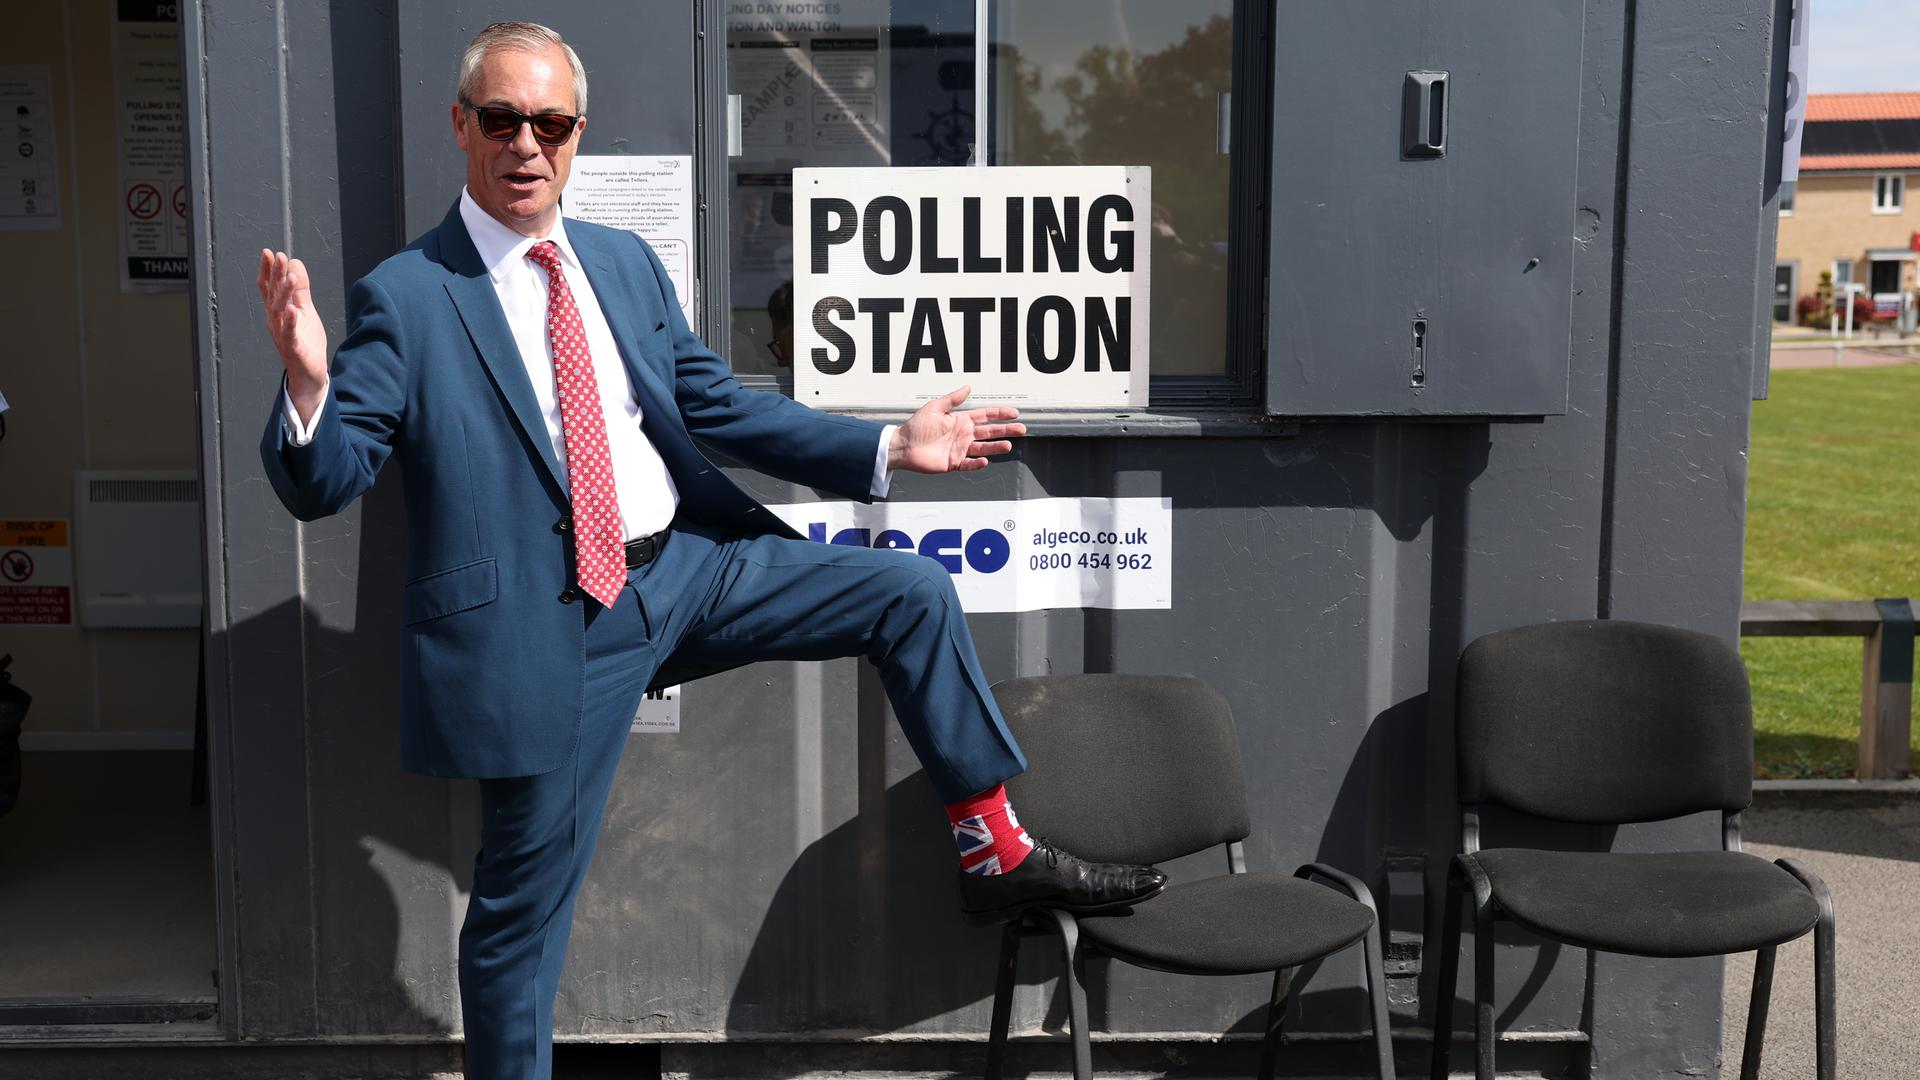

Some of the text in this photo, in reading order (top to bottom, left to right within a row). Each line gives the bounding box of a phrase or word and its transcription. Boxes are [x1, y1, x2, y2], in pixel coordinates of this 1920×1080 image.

[756, 4, 783, 14] DAY
[786, 4, 841, 14] NOTICES
[728, 21, 841, 32] TON AND WALTON
[126, 101, 163, 110] POLLING
[134, 113, 172, 121] OPENING
[810, 194, 1134, 275] POLLING
[811, 295, 1131, 375] STATION
[6, 521, 56, 531] RISK OF
[17, 535, 46, 546] FIRE
[1033, 527, 1148, 548] algeco.co.uk
[1030, 553, 1152, 570] 0800 454 962
